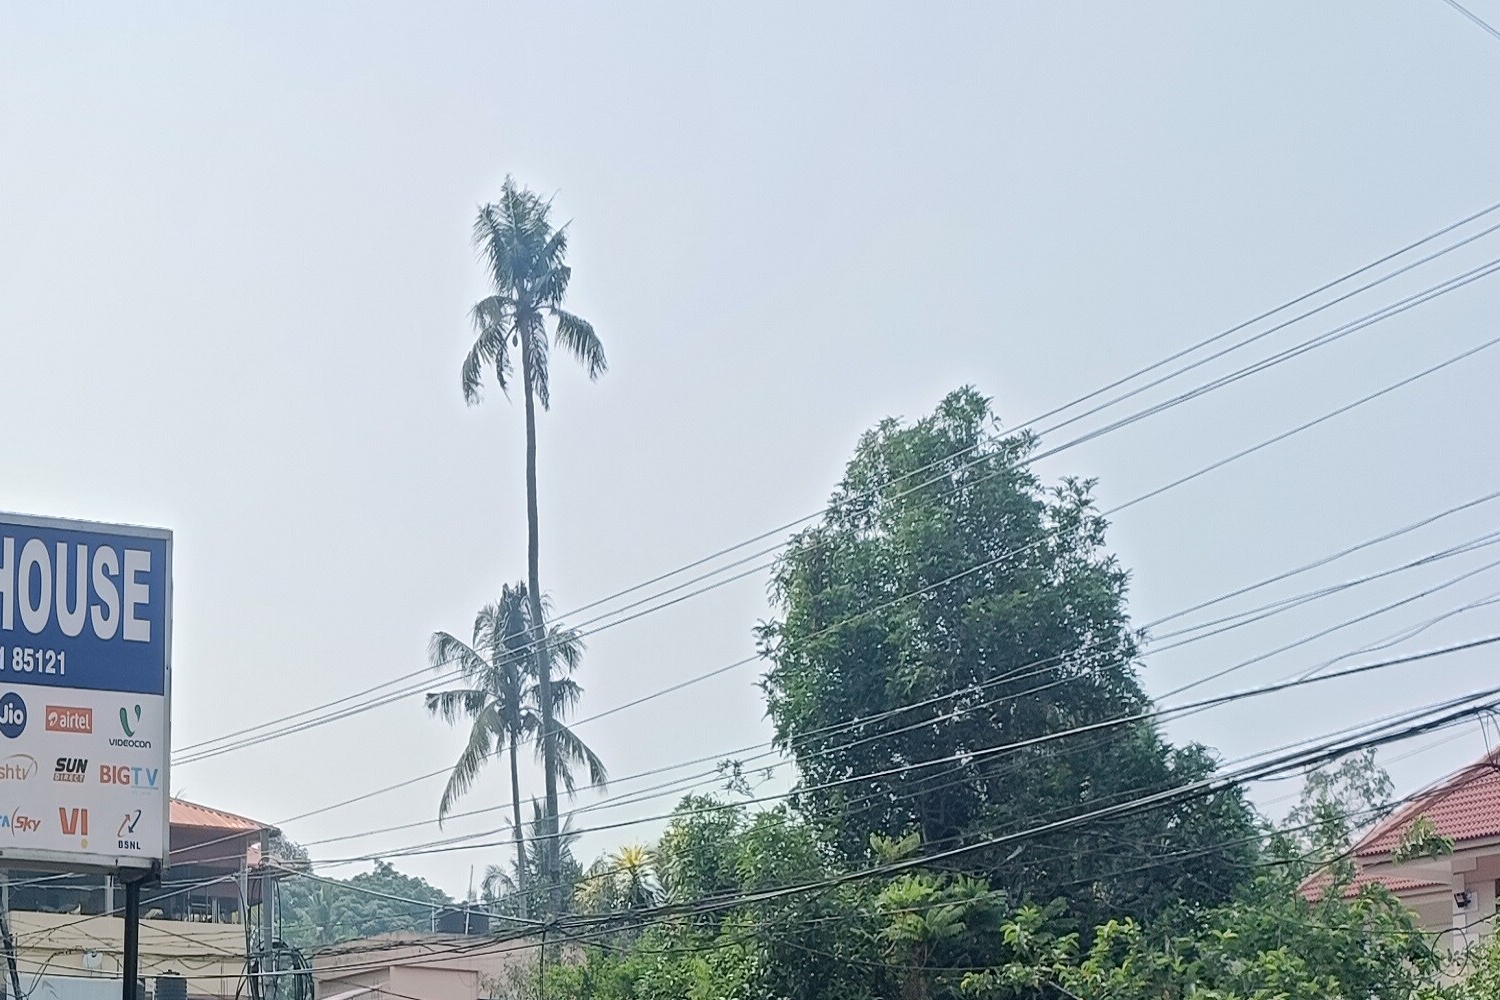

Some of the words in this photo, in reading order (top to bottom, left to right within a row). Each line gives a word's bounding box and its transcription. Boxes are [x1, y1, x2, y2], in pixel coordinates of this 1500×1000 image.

[11, 645, 67, 676] 85121
[59, 712, 91, 731] airtel
[54, 757, 89, 774] SUN
[53, 772, 86, 783] DIRECT
[117, 839, 142, 851] BSNL
